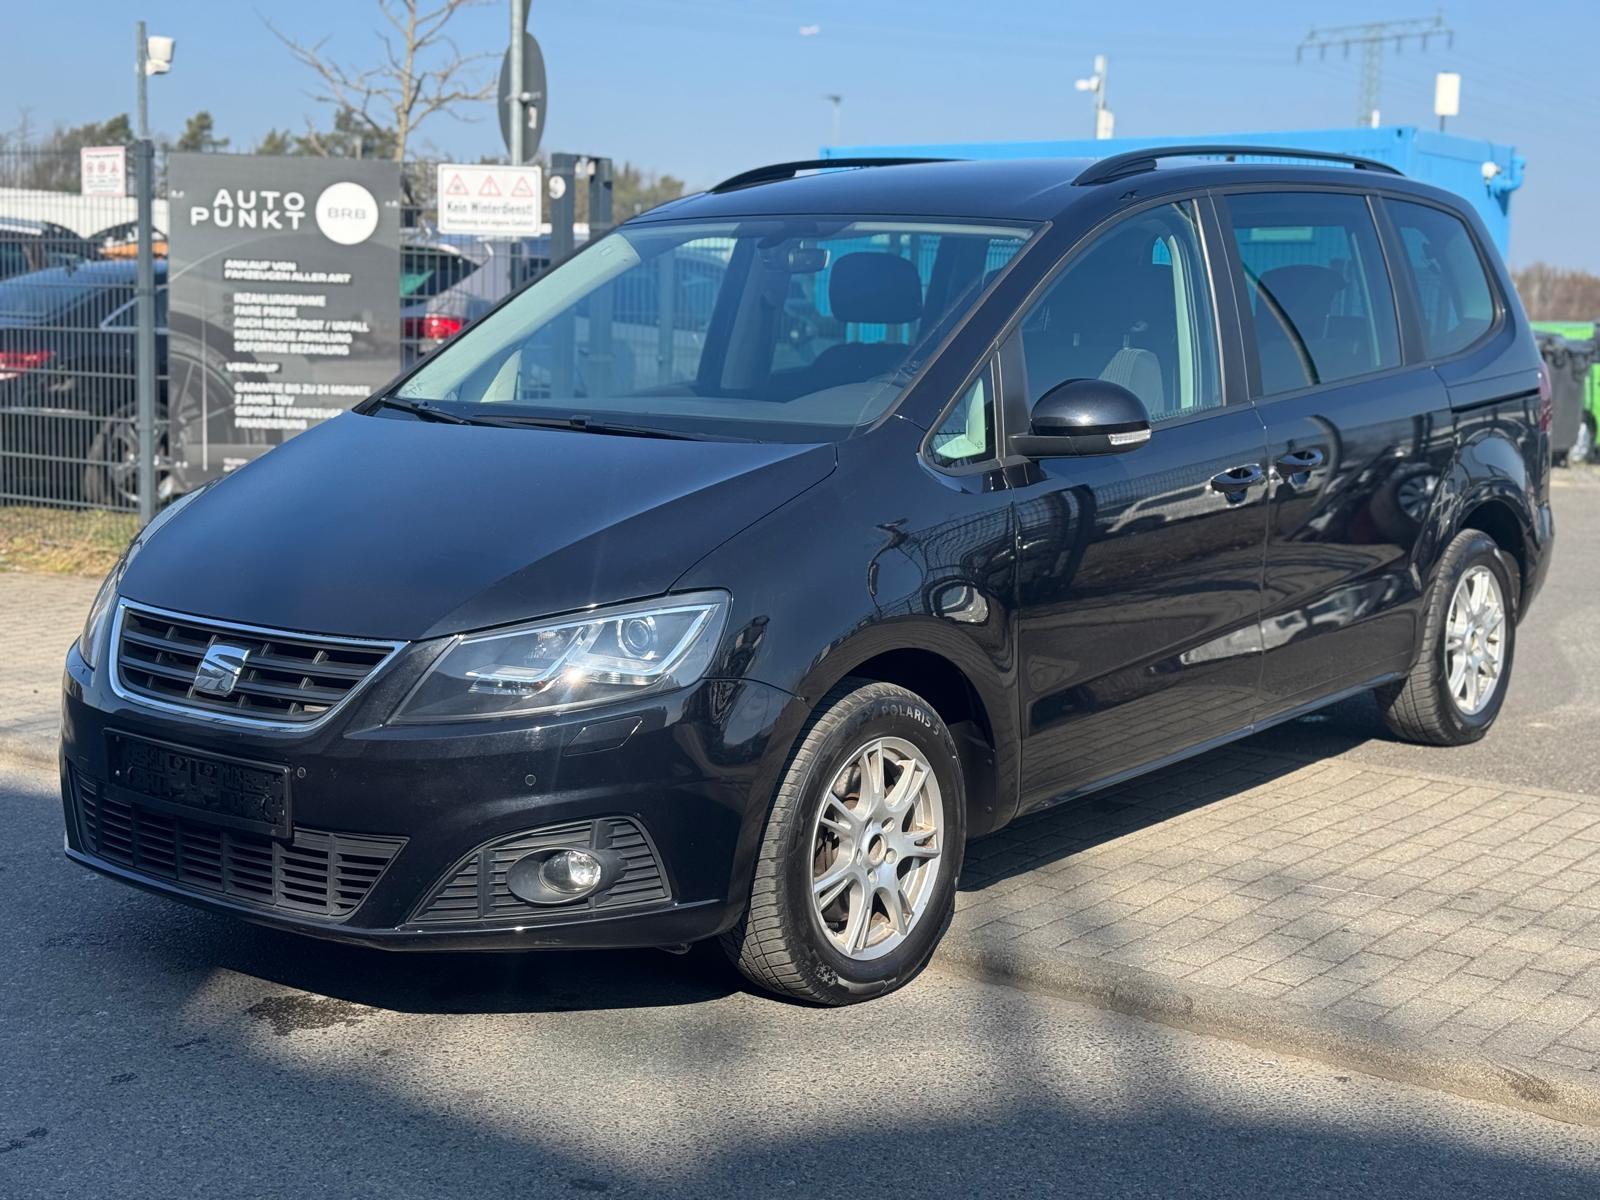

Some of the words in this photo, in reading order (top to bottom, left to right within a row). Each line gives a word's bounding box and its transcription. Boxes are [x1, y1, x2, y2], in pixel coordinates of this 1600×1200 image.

[212, 188, 306, 211] AUTO
[190, 206, 306, 230] PUNKT
[327, 206, 366, 220] BRB
[225, 260, 271, 270] ANKAUF
[272, 262, 296, 271] VON
[292, 272, 327, 282] ALLER
[328, 274, 350, 282] ART
[234, 305, 262, 316] FAIRE
[262, 306, 297, 318] PREISE
[234, 317, 262, 328] AUCH
[332, 321, 369, 332] UNFALL
[234, 330, 296, 342] KOSTENLOSE
[298, 332, 352, 344] ABHOLUNG
[234, 341, 289, 353] SOFORTIGE
[290, 343, 349, 355] BEZAHLUNG
[226, 362, 278, 372] VERKAUF
[234, 382, 284, 394] GARANTIE
[284, 383, 301, 394] BIS
[302, 384, 316, 395] ZU
[317, 384, 330, 396] 24
[330, 384, 371, 397] MONATE
[242, 394, 273, 405] JAHRE
[274, 394, 295, 406] TÜV
[234, 406, 285, 418] GEPRÜFTE
[234, 418, 308, 430] FINANZIERUNG
[881, 704, 931, 728] POLARIS
[933, 724, 940, 736] 5
